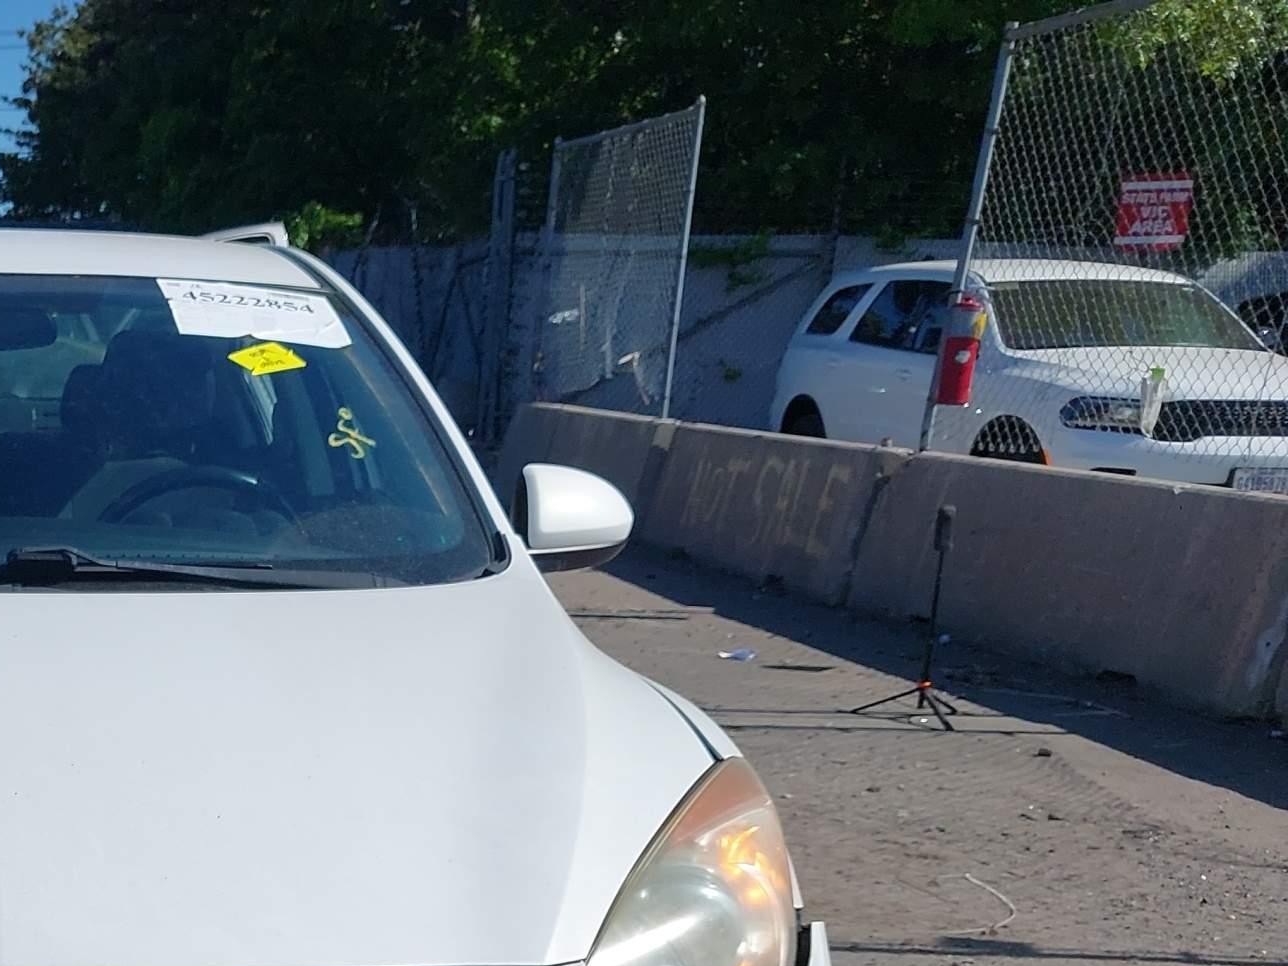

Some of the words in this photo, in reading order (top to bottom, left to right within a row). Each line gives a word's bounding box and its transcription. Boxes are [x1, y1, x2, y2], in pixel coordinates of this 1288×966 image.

[1140, 205, 1169, 219] VIC
[1129, 219, 1174, 235] AREA
[182, 290, 315, 316] 45222854
